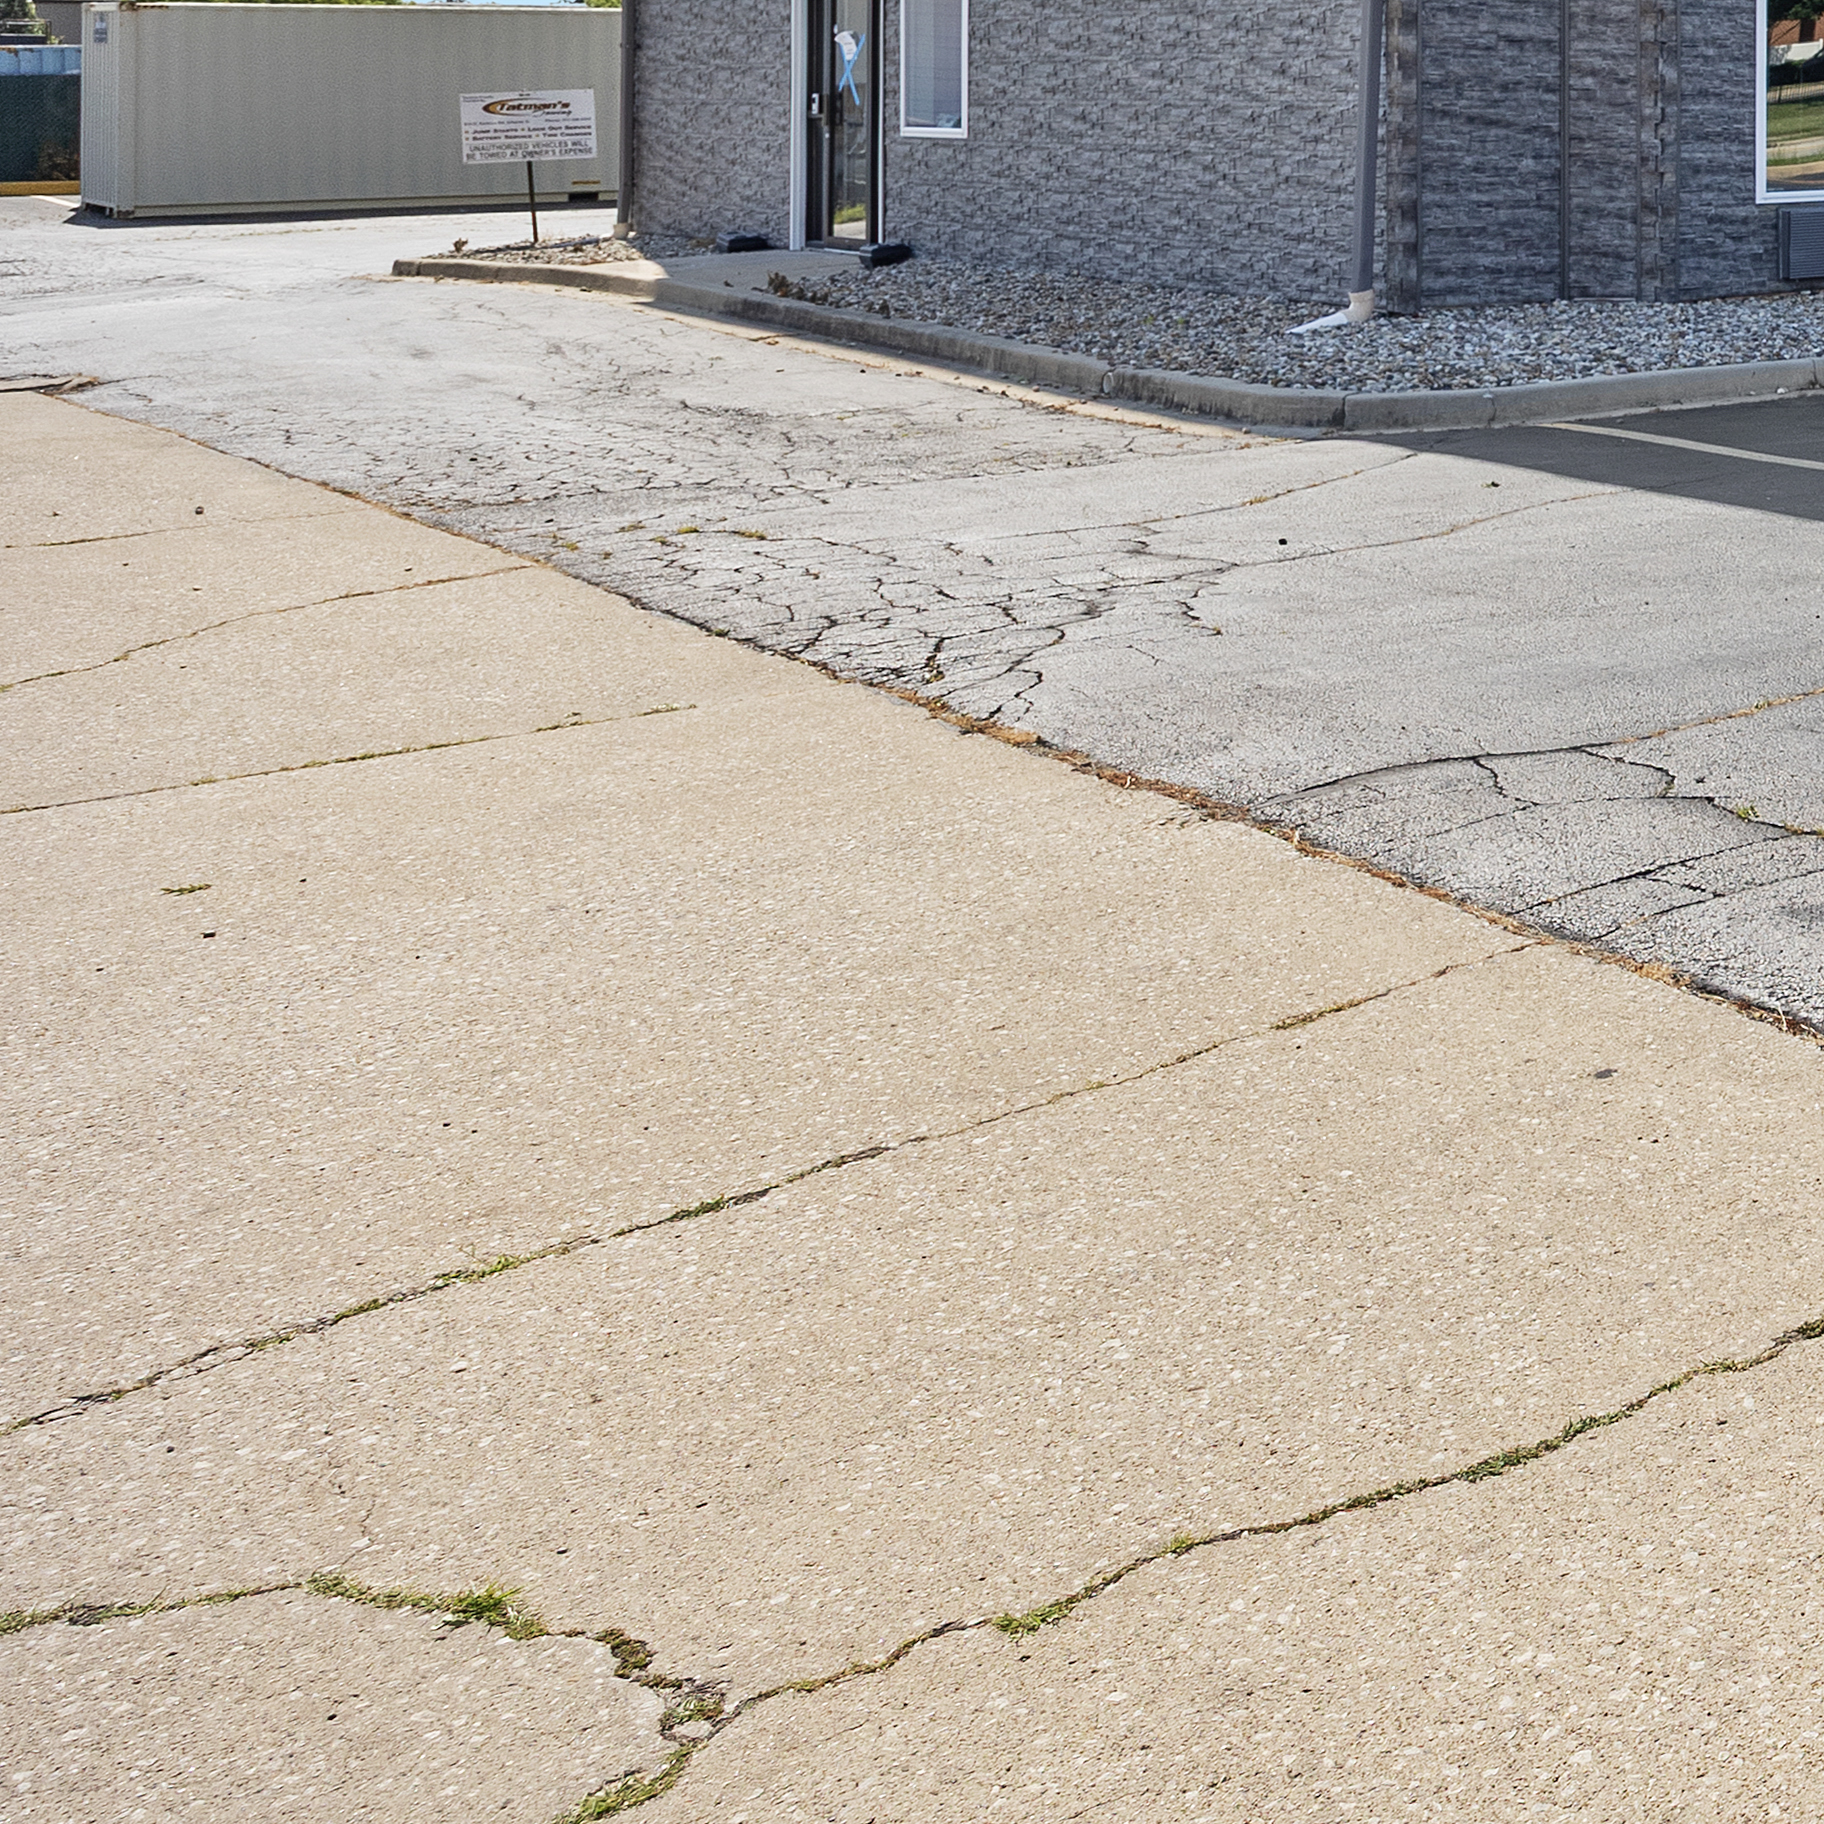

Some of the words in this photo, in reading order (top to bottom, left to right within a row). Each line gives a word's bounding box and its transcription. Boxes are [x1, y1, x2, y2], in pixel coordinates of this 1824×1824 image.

[469, 142, 529, 152] UNAUTHORIZED
[532, 141, 568, 150] VEHICLES
[559, 146, 593, 155] EXPENSE
